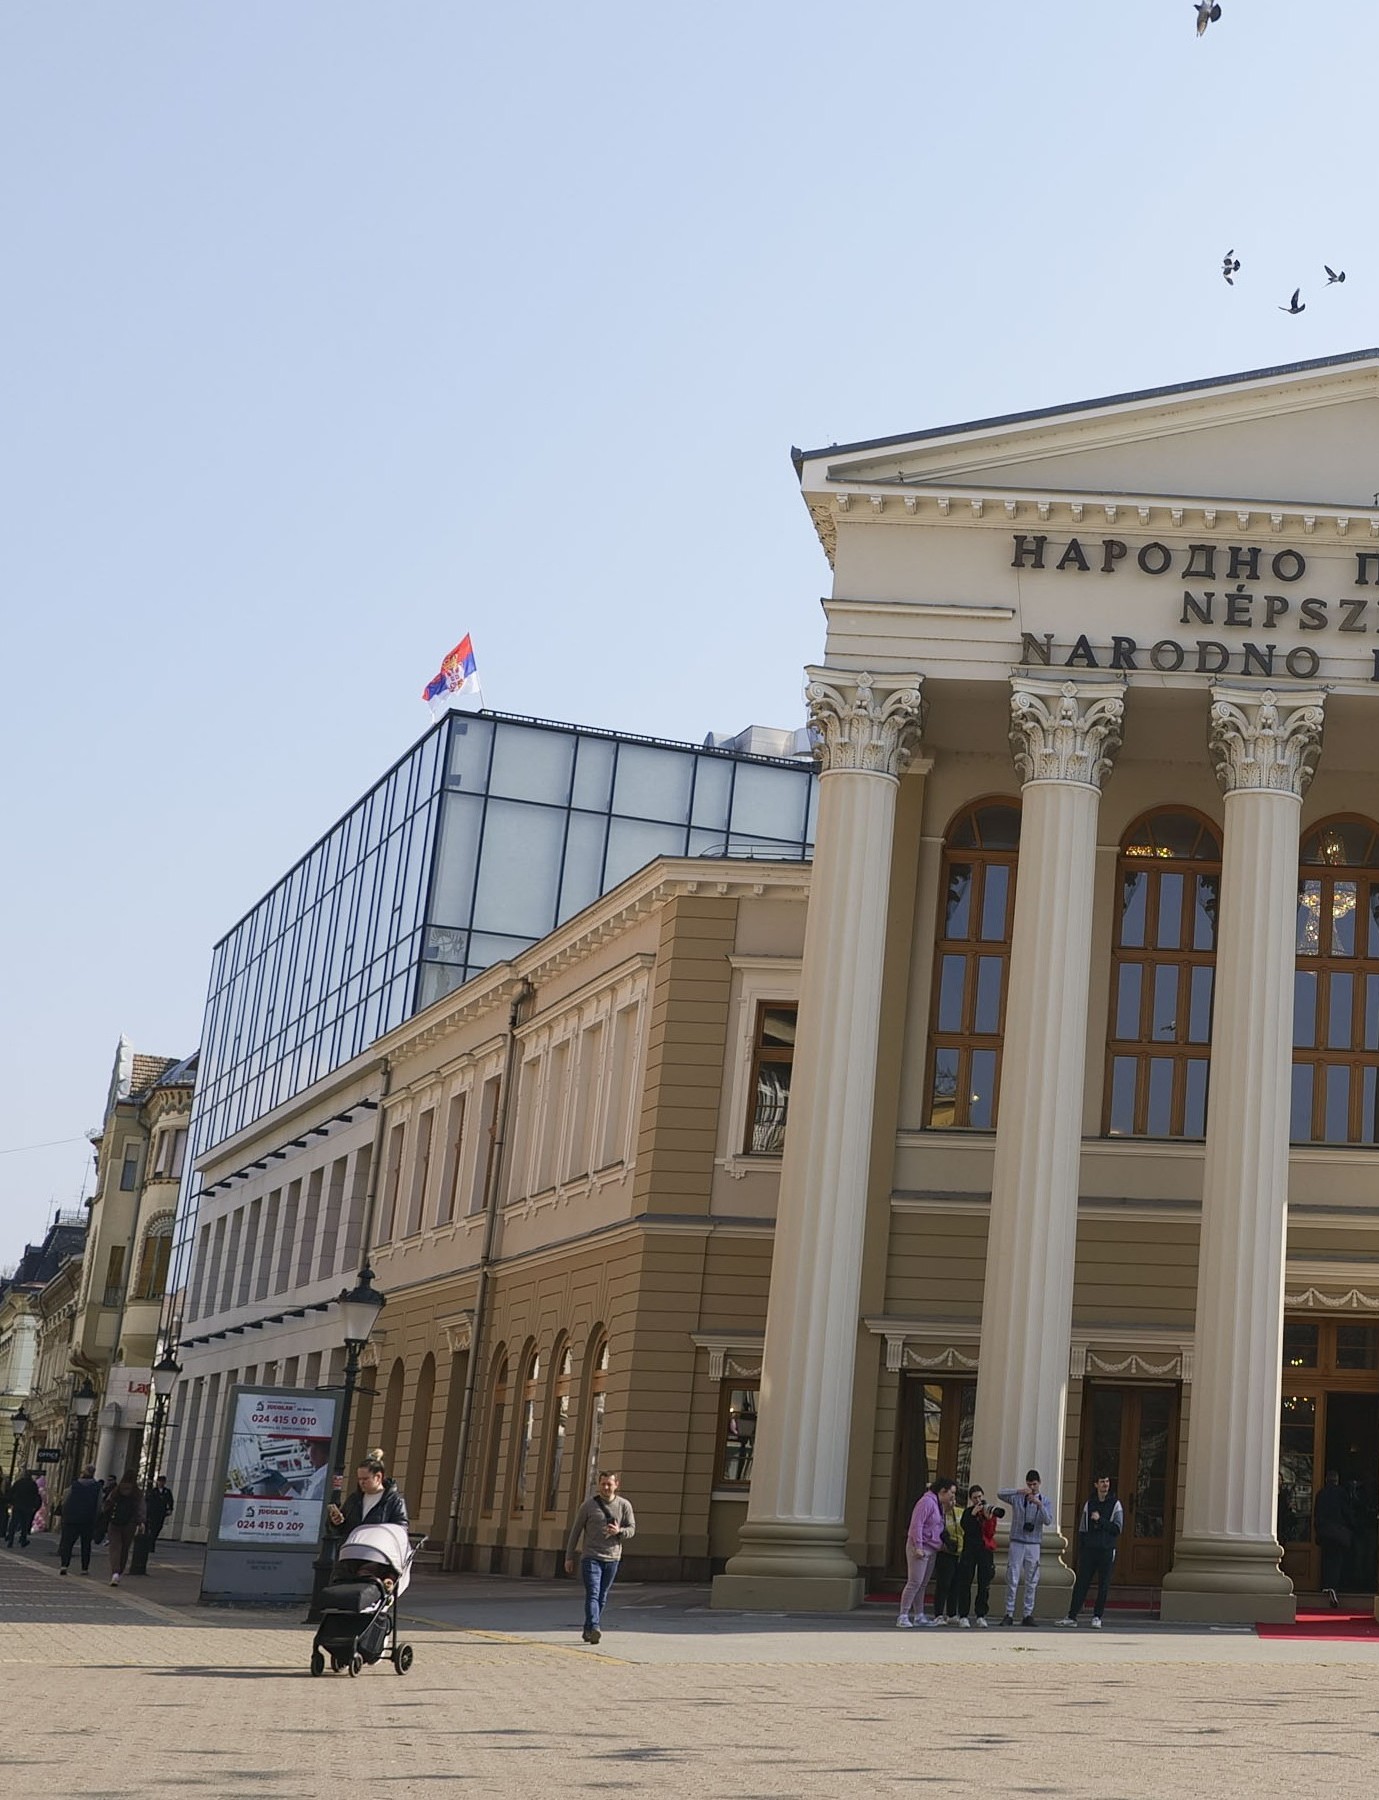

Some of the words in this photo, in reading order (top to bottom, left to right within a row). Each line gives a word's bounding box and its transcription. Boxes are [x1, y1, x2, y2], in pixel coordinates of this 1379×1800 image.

[1010, 534, 1306, 582] НАРОДНО
[1019, 632, 1320, 679] NARODNO
[252, 1414, 270, 1422] 024
[272, 1415, 289, 1424] 415
[292, 1416, 298, 1424] 0
[300, 1417, 317, 1426] 010
[237, 1520, 255, 1529] 024
[258, 1521, 275, 1530] 415
[286, 1522, 304, 1531] 209
